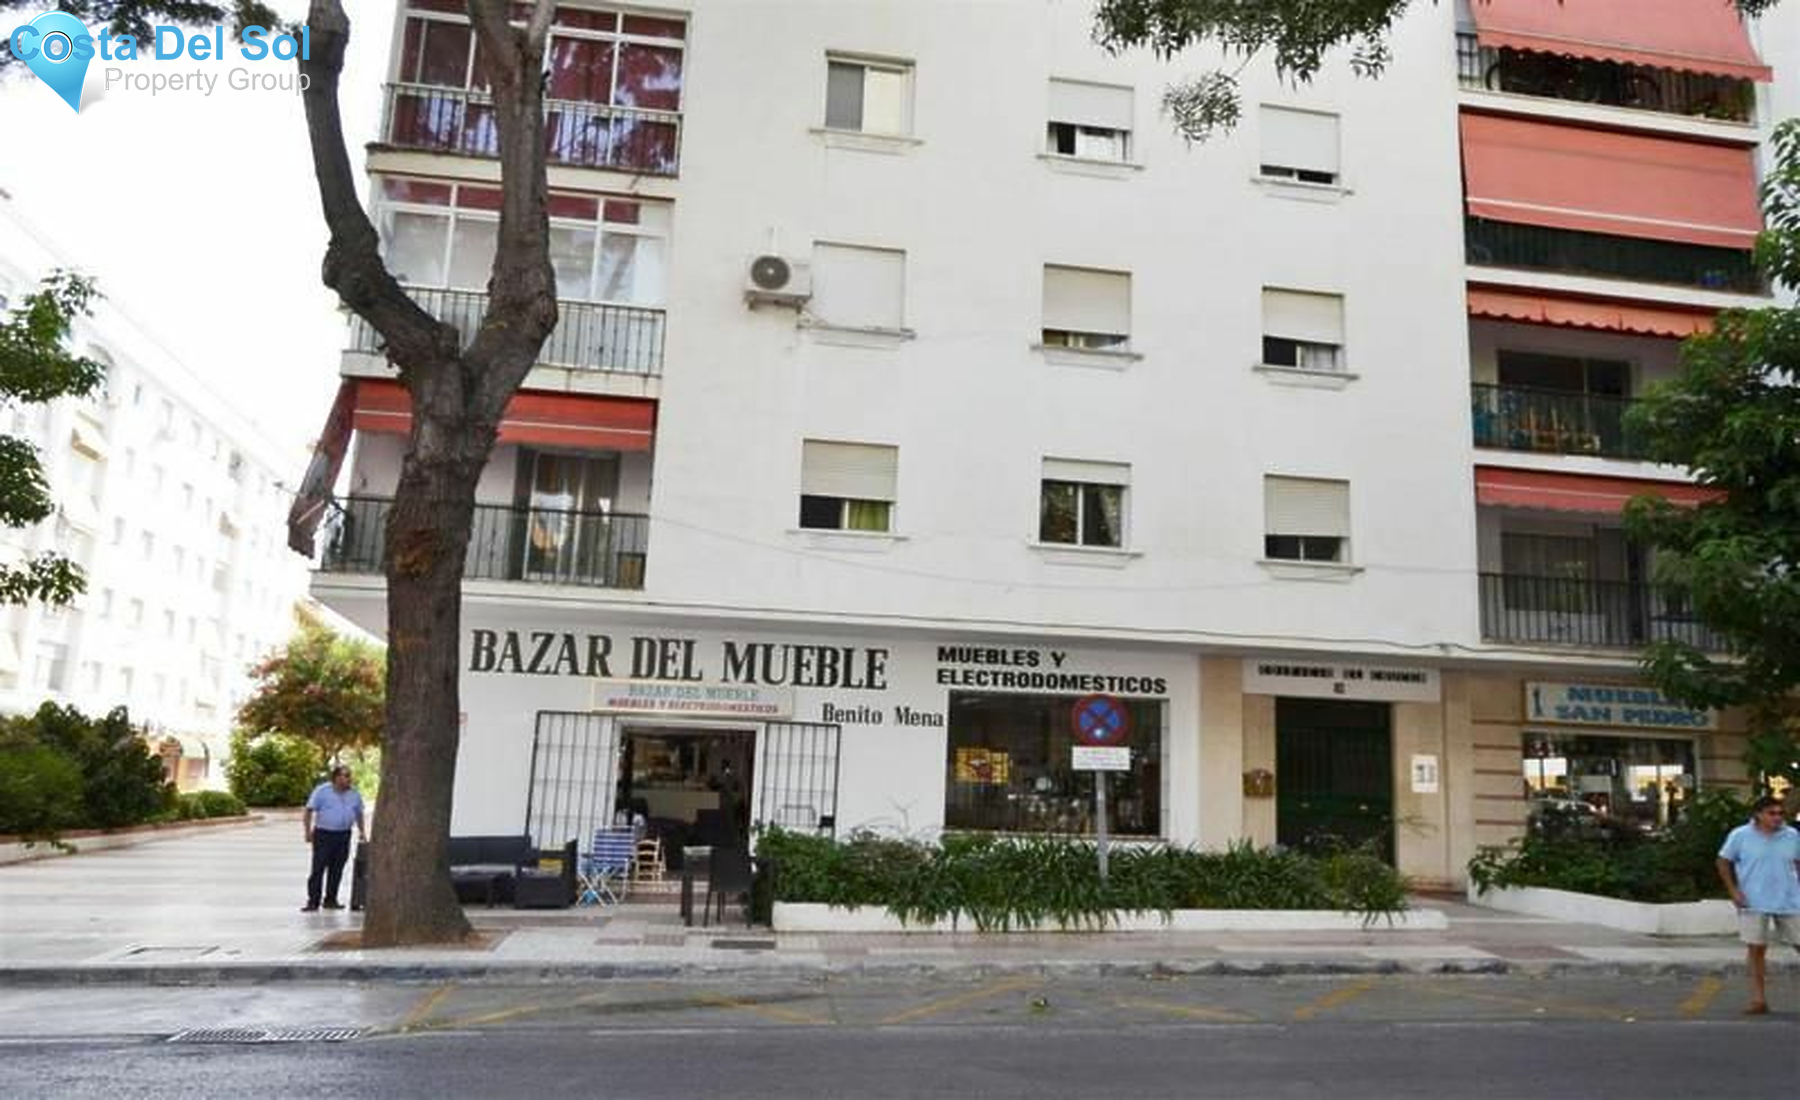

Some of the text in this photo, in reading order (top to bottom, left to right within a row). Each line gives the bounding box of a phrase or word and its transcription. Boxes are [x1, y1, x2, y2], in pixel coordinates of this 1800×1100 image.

[469, 629, 889, 690] BAZAR DEL MUEBLE
[937, 646, 1066, 668] MUEBLES Y
[937, 668, 1167, 694] ELECTRODOMESTICOS
[822, 702, 944, 727] Benito Mena
[1554, 704, 1709, 728] SAN PEDRO
